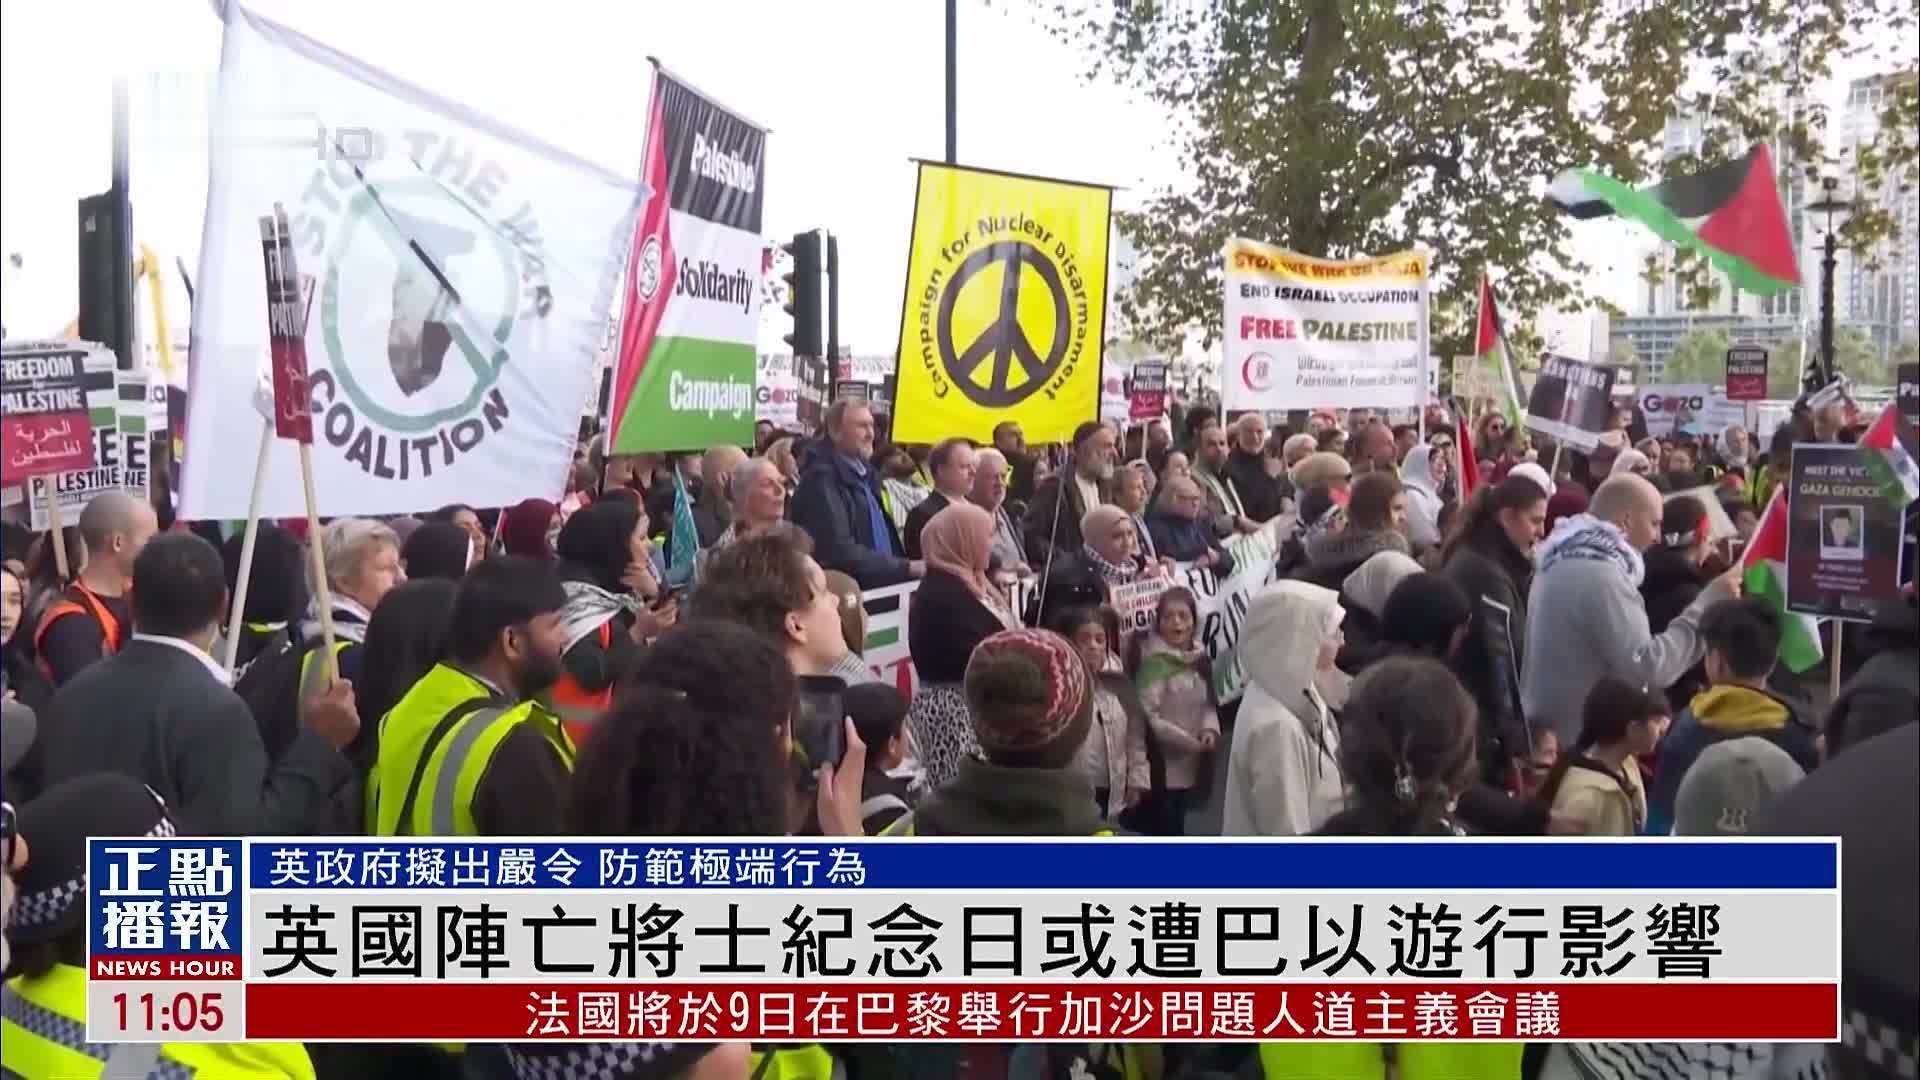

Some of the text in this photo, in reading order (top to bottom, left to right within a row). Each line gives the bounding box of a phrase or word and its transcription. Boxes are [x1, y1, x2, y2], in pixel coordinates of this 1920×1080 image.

[404, 129, 508, 209] THE
[690, 132, 755, 193] Palestine
[676, 257, 753, 314] Solidarity
[919, 268, 949, 398] Campaign
[941, 230, 971, 263] for
[977, 212, 1054, 244] Nuclear
[1044, 241, 1089, 400] Disarmament
[1240, 283, 1269, 299] END
[1240, 316, 1418, 341] FREE PALESTINE
[669, 369, 752, 419] Campaign
[309, 368, 509, 481] COALITION
[33, 468, 121, 497] PLESTINE
